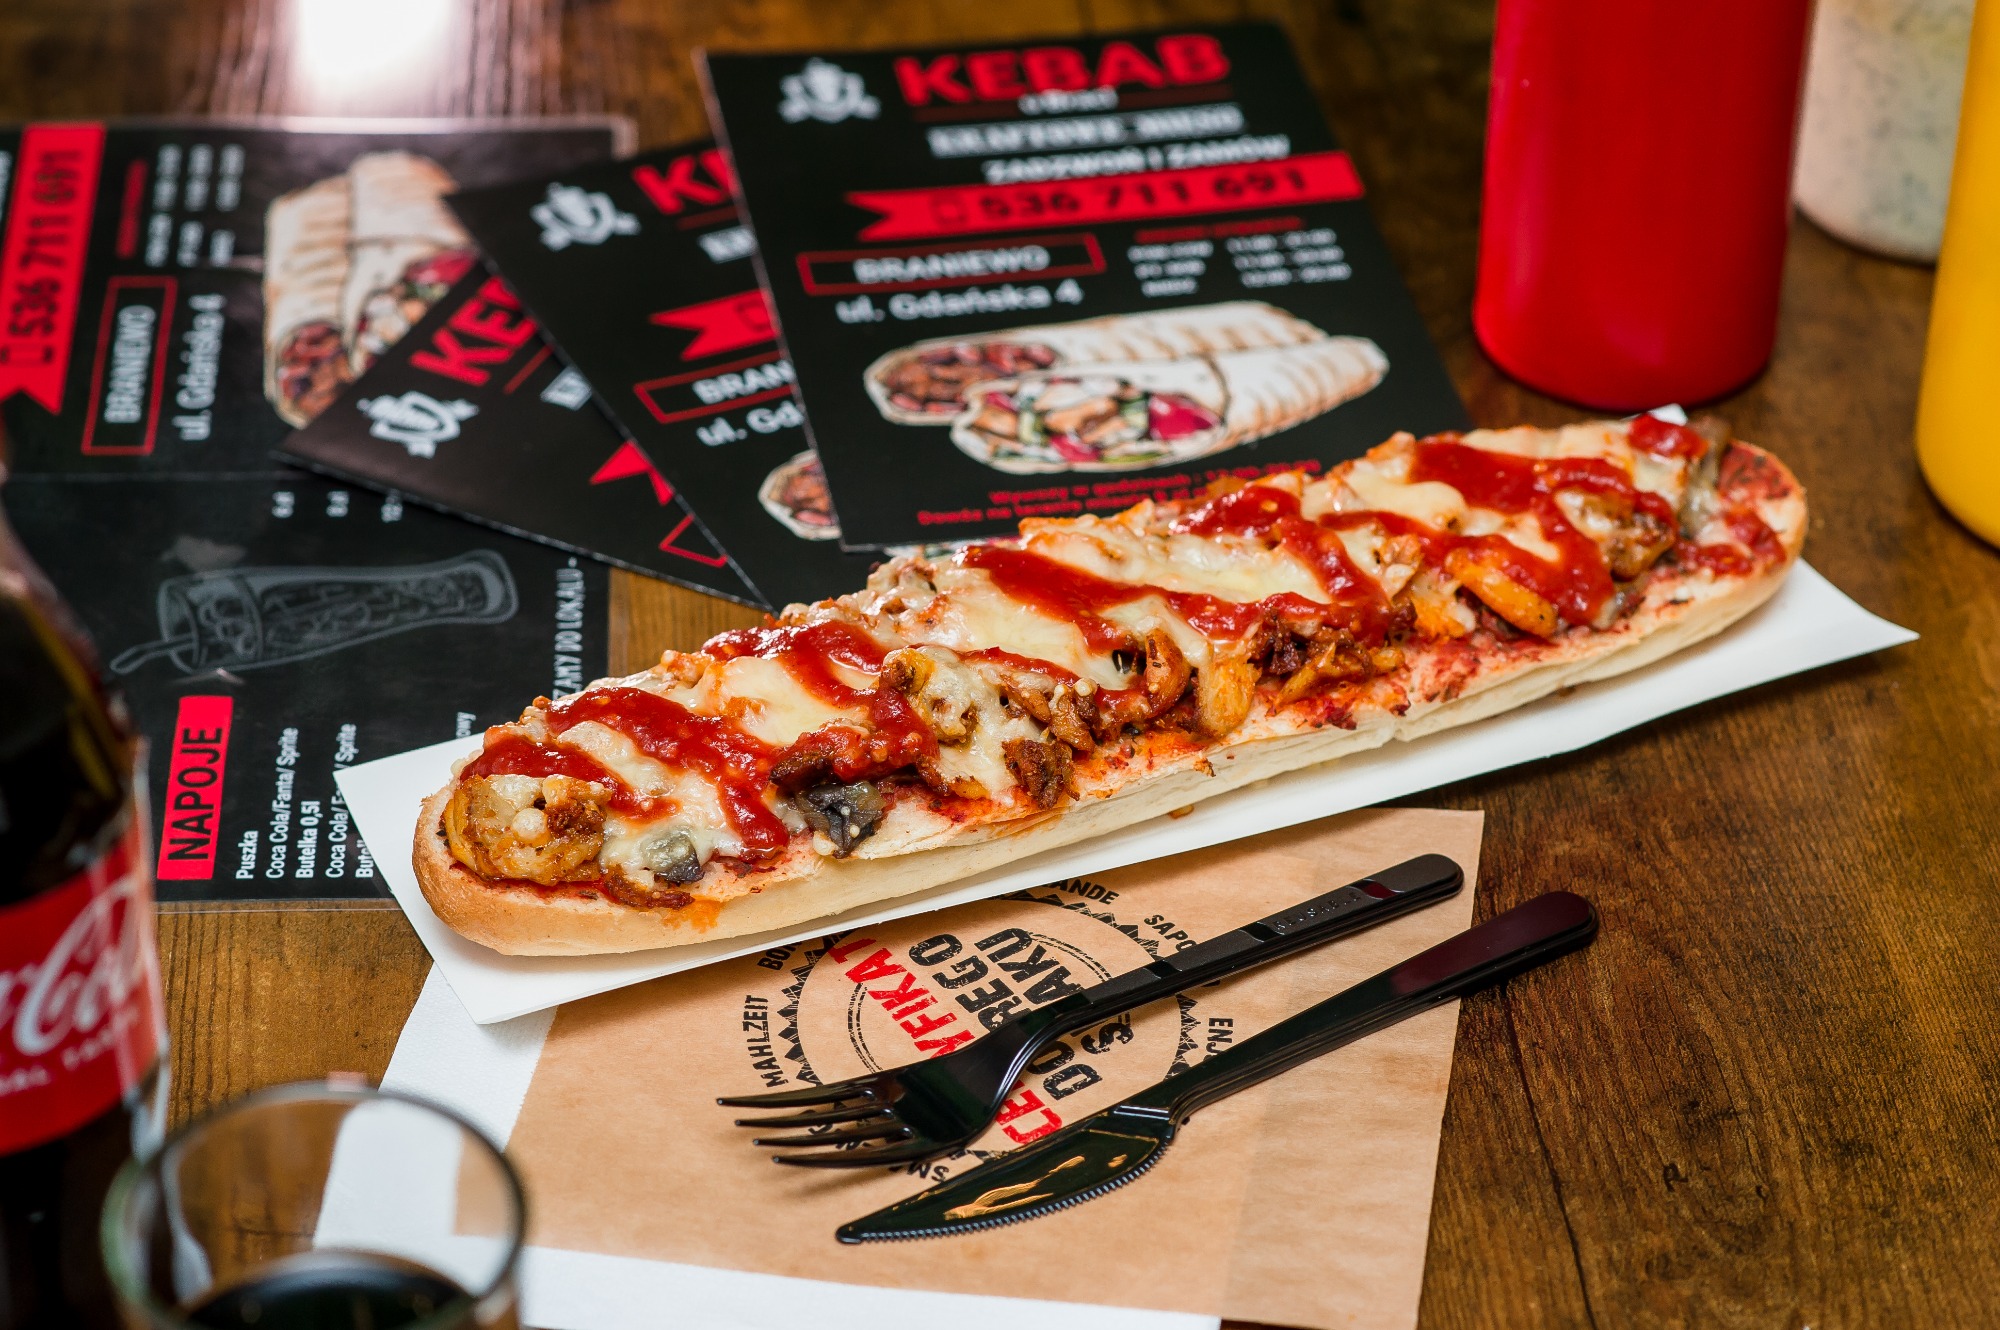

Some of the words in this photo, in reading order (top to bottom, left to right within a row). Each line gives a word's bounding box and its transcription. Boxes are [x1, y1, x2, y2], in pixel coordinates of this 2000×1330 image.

[893, 34, 1231, 105] KEBAB
[33, 150, 80, 204] 691
[980, 191, 1082, 219] 536
[1101, 177, 1191, 210] 711
[1211, 166, 1306, 196] 691
[19, 214, 71, 268] 711
[854, 245, 1050, 284] BRANIEWO
[8, 279, 62, 337] 536
[188, 293, 227, 311] 4
[835, 294, 886, 324] ul.
[889, 283, 1051, 320] Gdańska
[1055, 278, 1084, 304] 4
[104, 304, 156, 424] BRANIEWO
[176, 311, 226, 410] Gdańska
[692, 359, 797, 404] BRAN
[172, 409, 213, 441] ul.
[696, 416, 747, 446] ul.
[746, 400, 804, 434] Gd
[554, 568, 586, 630] LOKALU
[554, 630, 583, 652] DO
[276, 727, 301, 766] Sprite
[334, 723, 360, 763] Sprite
[167, 727, 223, 861] NAPOJE
[236, 830, 259, 879] Puszka
[266, 845, 287, 879] Coca
[295, 828, 318, 878] Butelka
[325, 845, 347, 878] Coca
[1143, 914, 1201, 953] SAPO
[974, 928, 1134, 1054] SAKU
[742, 994, 789, 1088] MAHLZEIT
